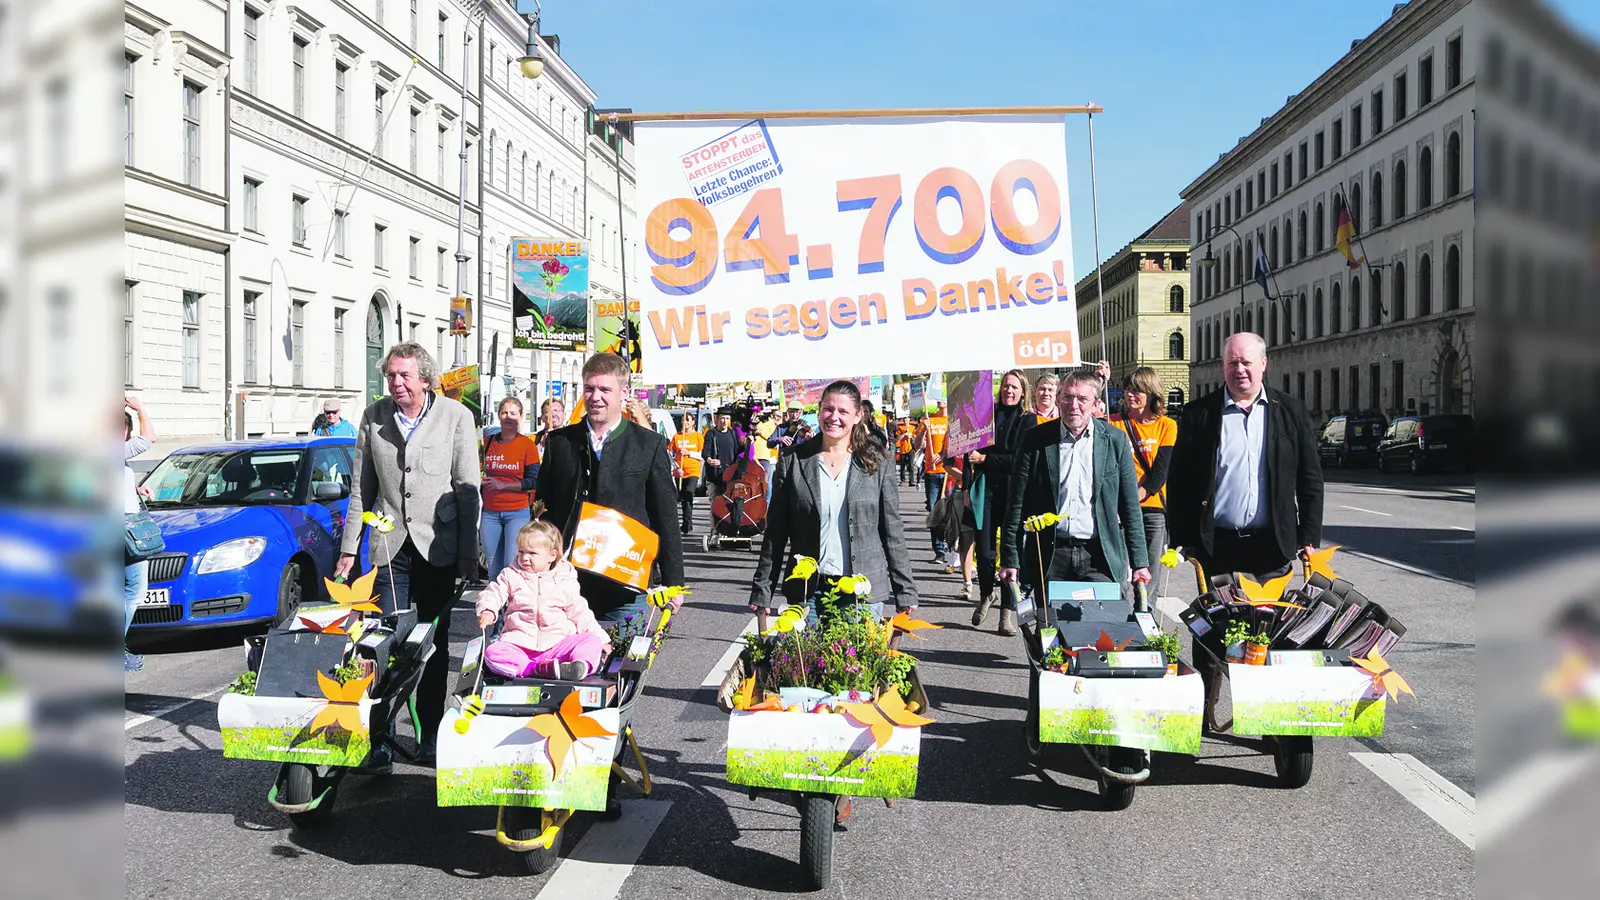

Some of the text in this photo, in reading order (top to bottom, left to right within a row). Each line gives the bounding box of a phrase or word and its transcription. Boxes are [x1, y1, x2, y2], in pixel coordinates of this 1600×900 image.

[681, 130, 763, 169] STOPPT das
[688, 141, 767, 181] ARTENSTERBEN
[693, 157, 773, 196] Letzte Chance:
[644, 158, 1062, 296] 94.700
[516, 242, 582, 256] DANKE!
[647, 260, 1070, 350] Wir sagen Danke!
[515, 328, 585, 341] Ich bin bedroht!
[1018, 337, 1067, 362] ödp
[491, 461, 520, 470] Bienen!
[143, 590, 167, 604] 311
